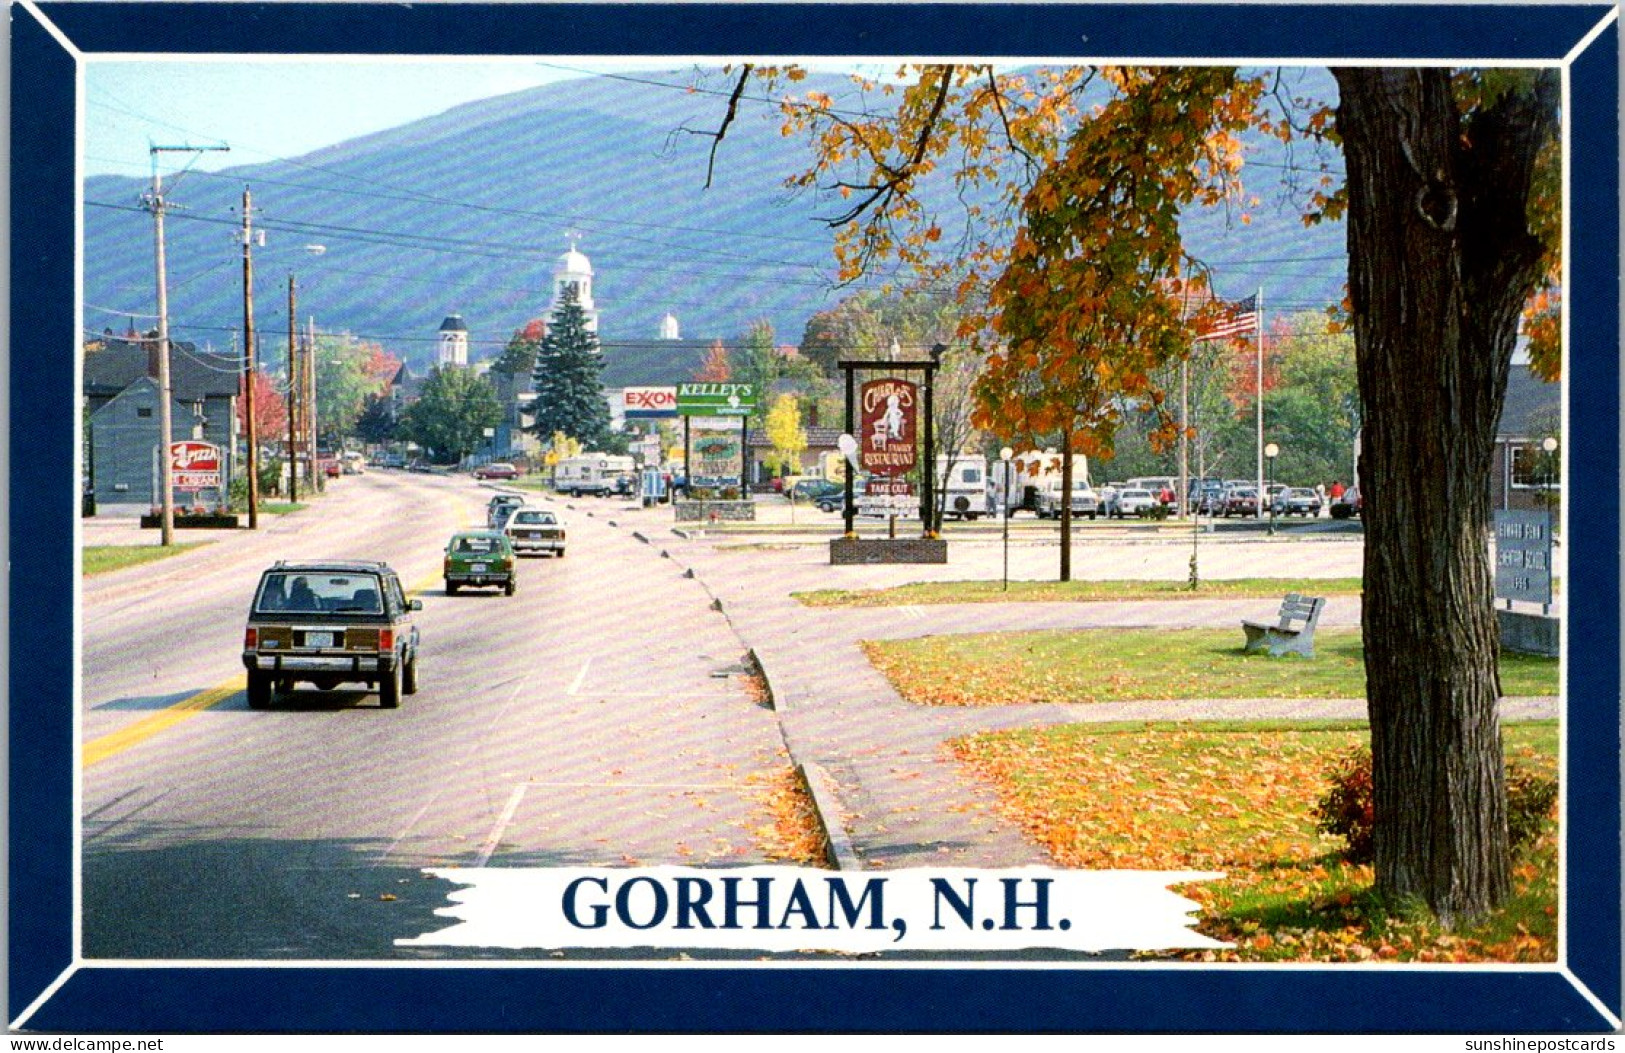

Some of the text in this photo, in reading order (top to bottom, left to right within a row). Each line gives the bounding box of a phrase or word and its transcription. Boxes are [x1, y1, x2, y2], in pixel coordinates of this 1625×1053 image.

[680, 383, 752, 396] KELLEY'S
[871, 484, 908, 495] TAKE OUT
